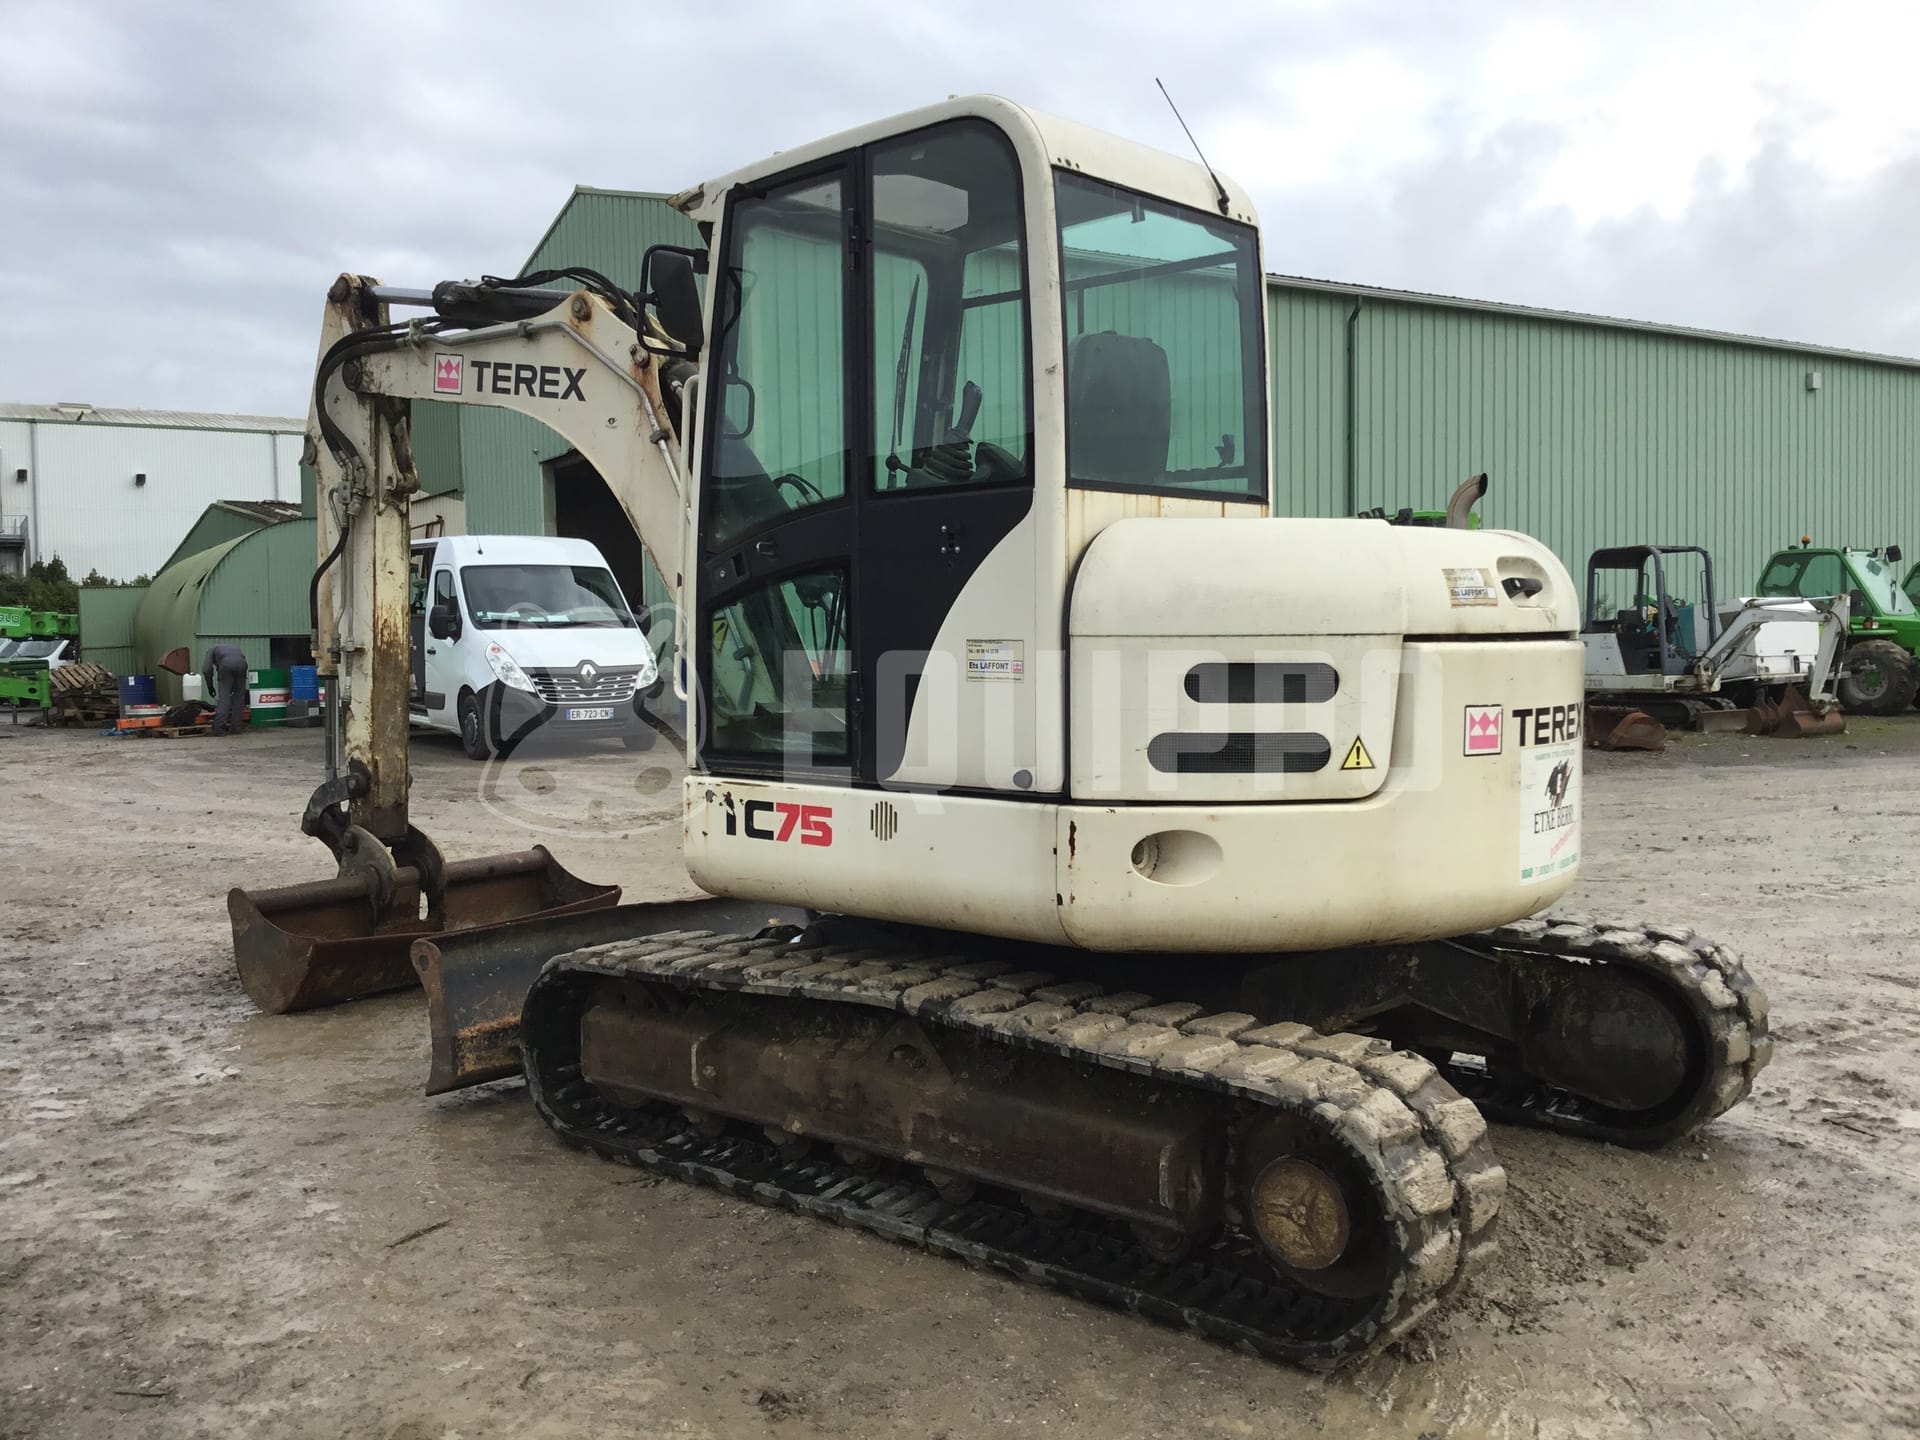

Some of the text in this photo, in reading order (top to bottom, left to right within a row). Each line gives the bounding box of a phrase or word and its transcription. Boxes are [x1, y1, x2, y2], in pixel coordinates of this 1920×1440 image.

[471, 361, 587, 402] TEREX
[969, 661, 1009, 670] Ets LAFFONT
[1512, 701, 1583, 747] TEREX
